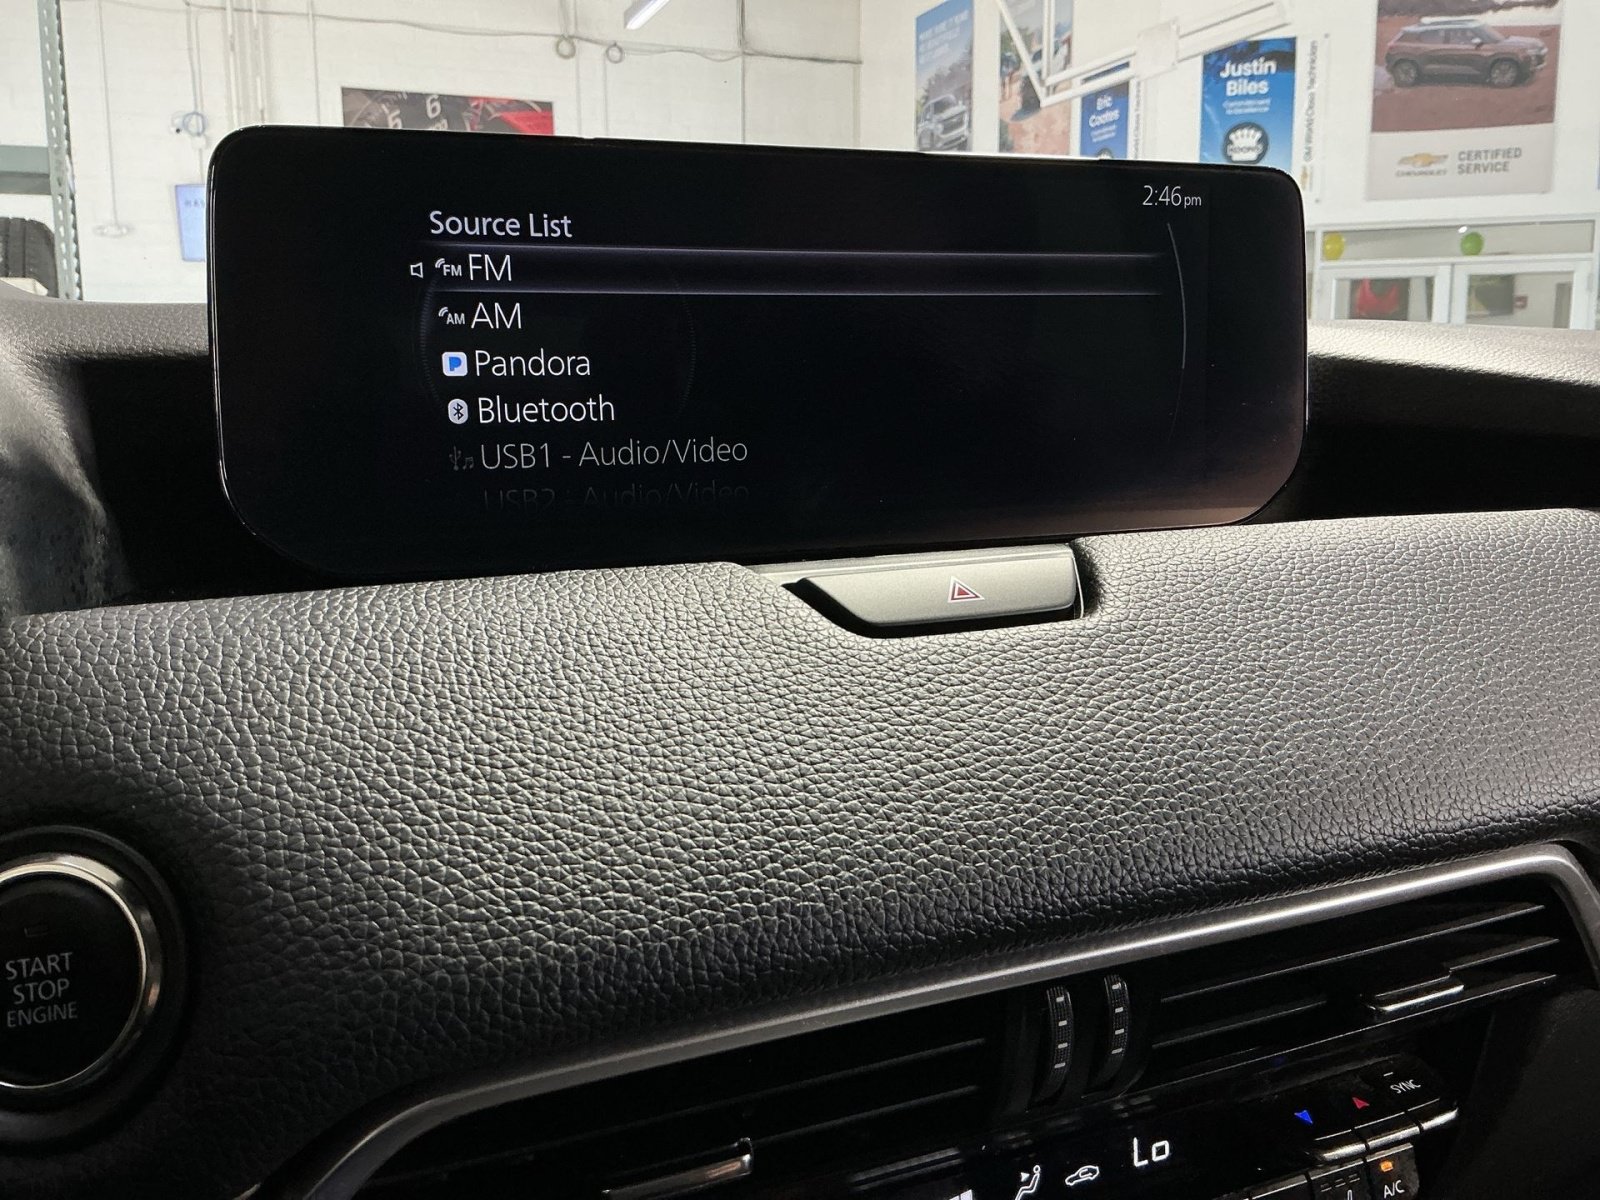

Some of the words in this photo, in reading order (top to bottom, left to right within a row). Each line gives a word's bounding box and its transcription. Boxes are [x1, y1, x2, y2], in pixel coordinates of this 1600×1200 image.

[1219, 56, 1277, 79] Justin
[1225, 78, 1269, 97] Biles
[1456, 161, 1510, 176] SERVICE
[1457, 147, 1523, 162] CERTIFIED
[429, 209, 521, 237] Source
[529, 211, 573, 239] List
[468, 253, 512, 282] FM
[470, 301, 522, 330] AM
[474, 348, 591, 378] Pandora
[478, 394, 616, 424] Bluetooth
[480, 441, 551, 470] USB1
[578, 435, 748, 468] Audio/Video
[5, 951, 73, 981] START
[12, 977, 70, 1006] STOP
[6, 1000, 78, 1028] ENGINE
[1389, 1079, 1422, 1095] SYNC
[1132, 1136, 1170, 1167] Lo
[1383, 1179, 1405, 1199] A/C
